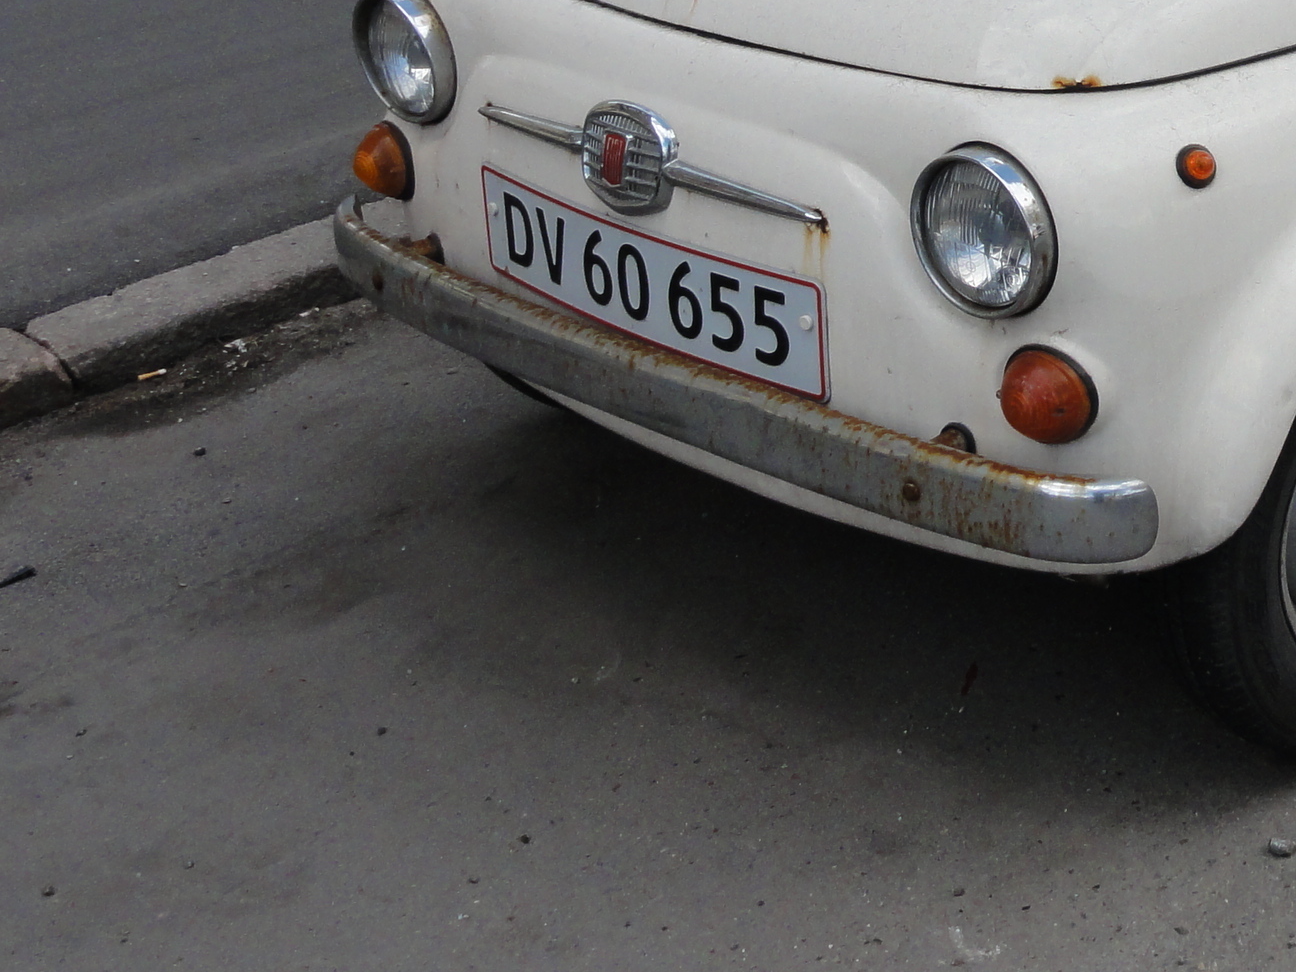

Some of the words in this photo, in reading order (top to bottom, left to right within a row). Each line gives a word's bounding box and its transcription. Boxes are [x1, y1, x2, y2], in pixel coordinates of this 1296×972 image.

[503, 191, 565, 285] DV
[583, 229, 650, 321] 60
[668, 260, 790, 367] 655
